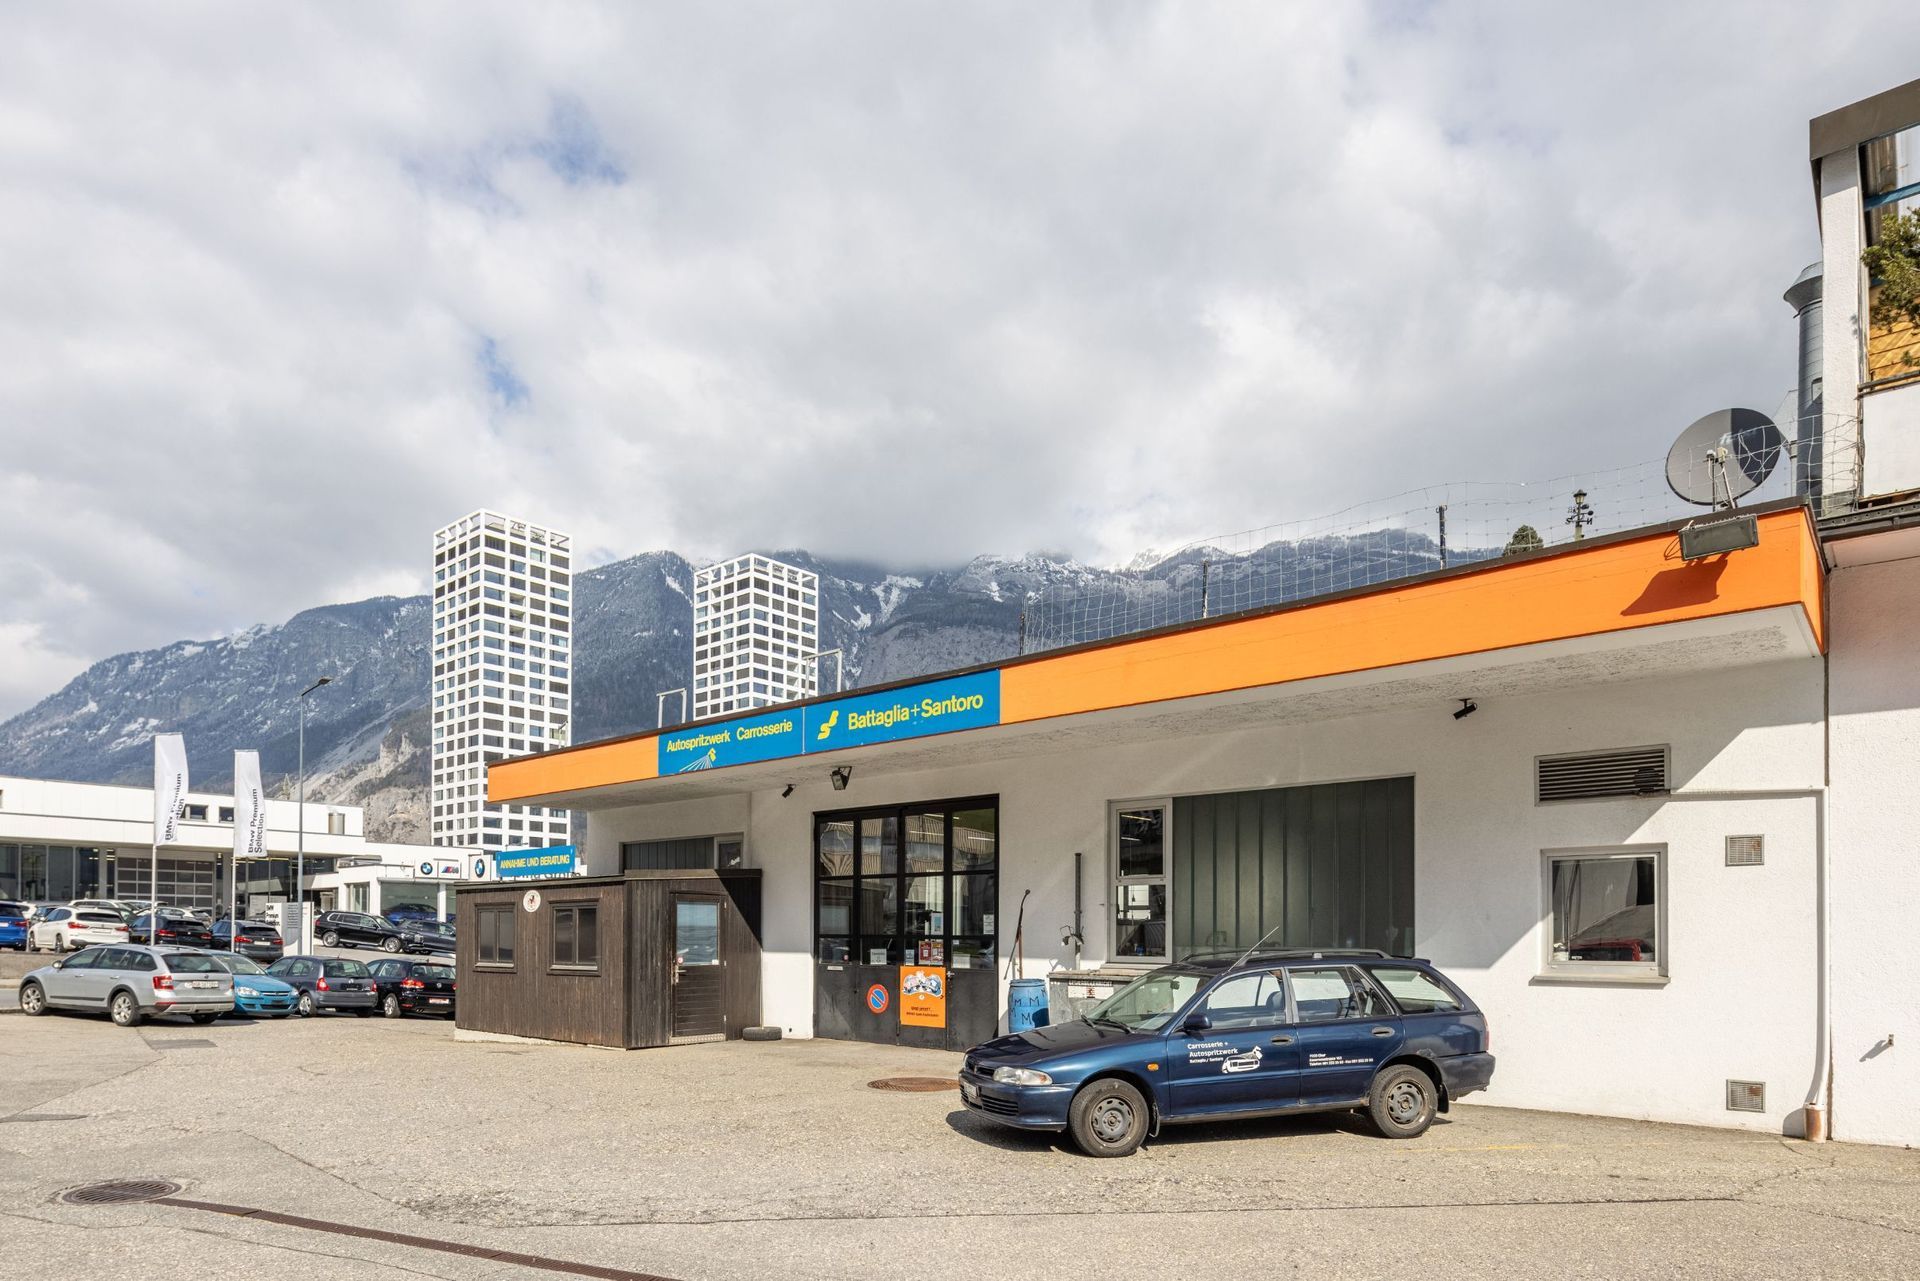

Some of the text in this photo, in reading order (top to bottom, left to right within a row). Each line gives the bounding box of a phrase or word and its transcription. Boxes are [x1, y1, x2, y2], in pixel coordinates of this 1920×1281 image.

[667, 719, 792, 753] Autospritzwerk Carrosserie
[254, 813, 265, 853] Selection
[500, 854, 570, 869] ANNAHME UND BERATUNG
[1014, 996, 1039, 1007] M M
[1022, 1012, 1032, 1025] M
[1187, 1041, 1223, 1050] Carrosserie
[1189, 1048, 1239, 1058] Autospritzwerk
